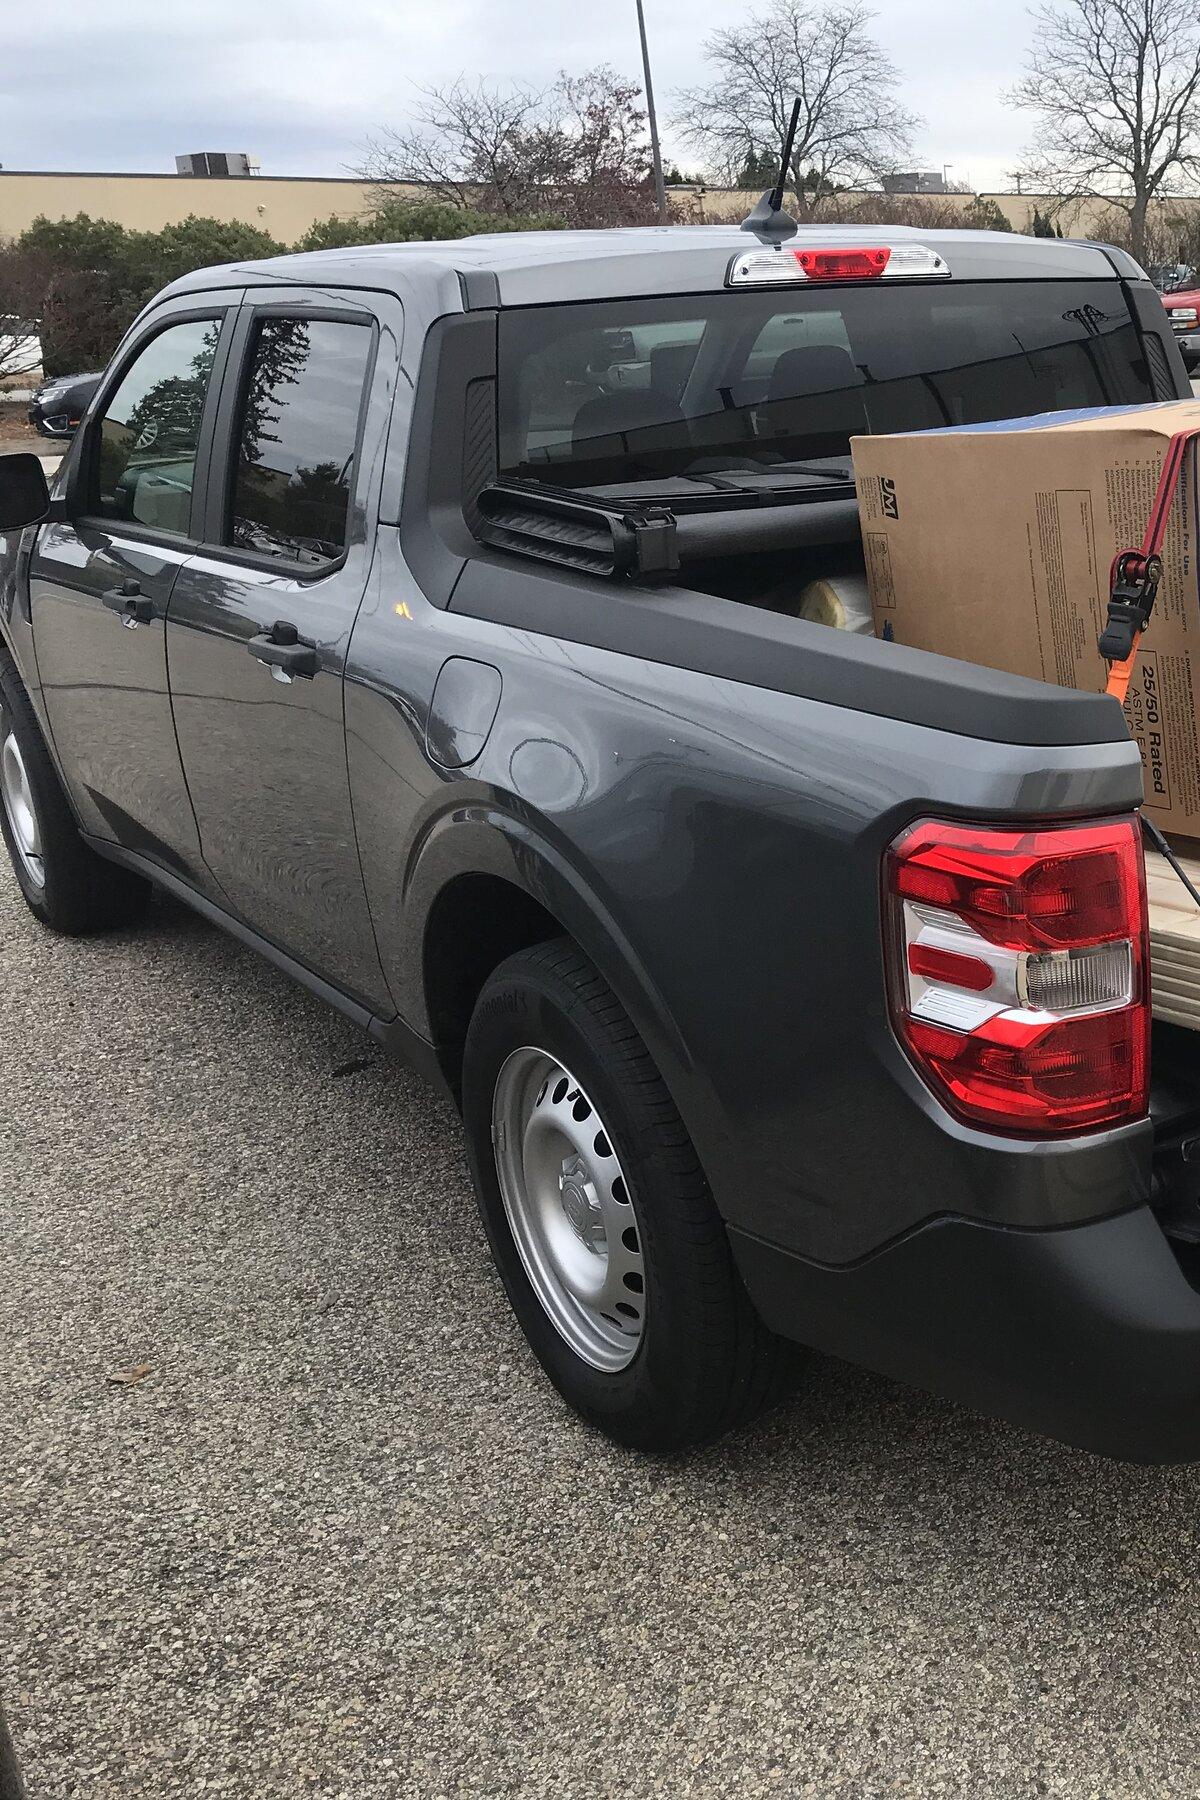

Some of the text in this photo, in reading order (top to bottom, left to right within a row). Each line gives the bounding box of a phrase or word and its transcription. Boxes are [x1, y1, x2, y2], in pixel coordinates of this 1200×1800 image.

[880, 477, 899, 519] JM
[1132, 688, 1144, 732] ASTM
[1143, 666, 1165, 794] 25/50 Rated
